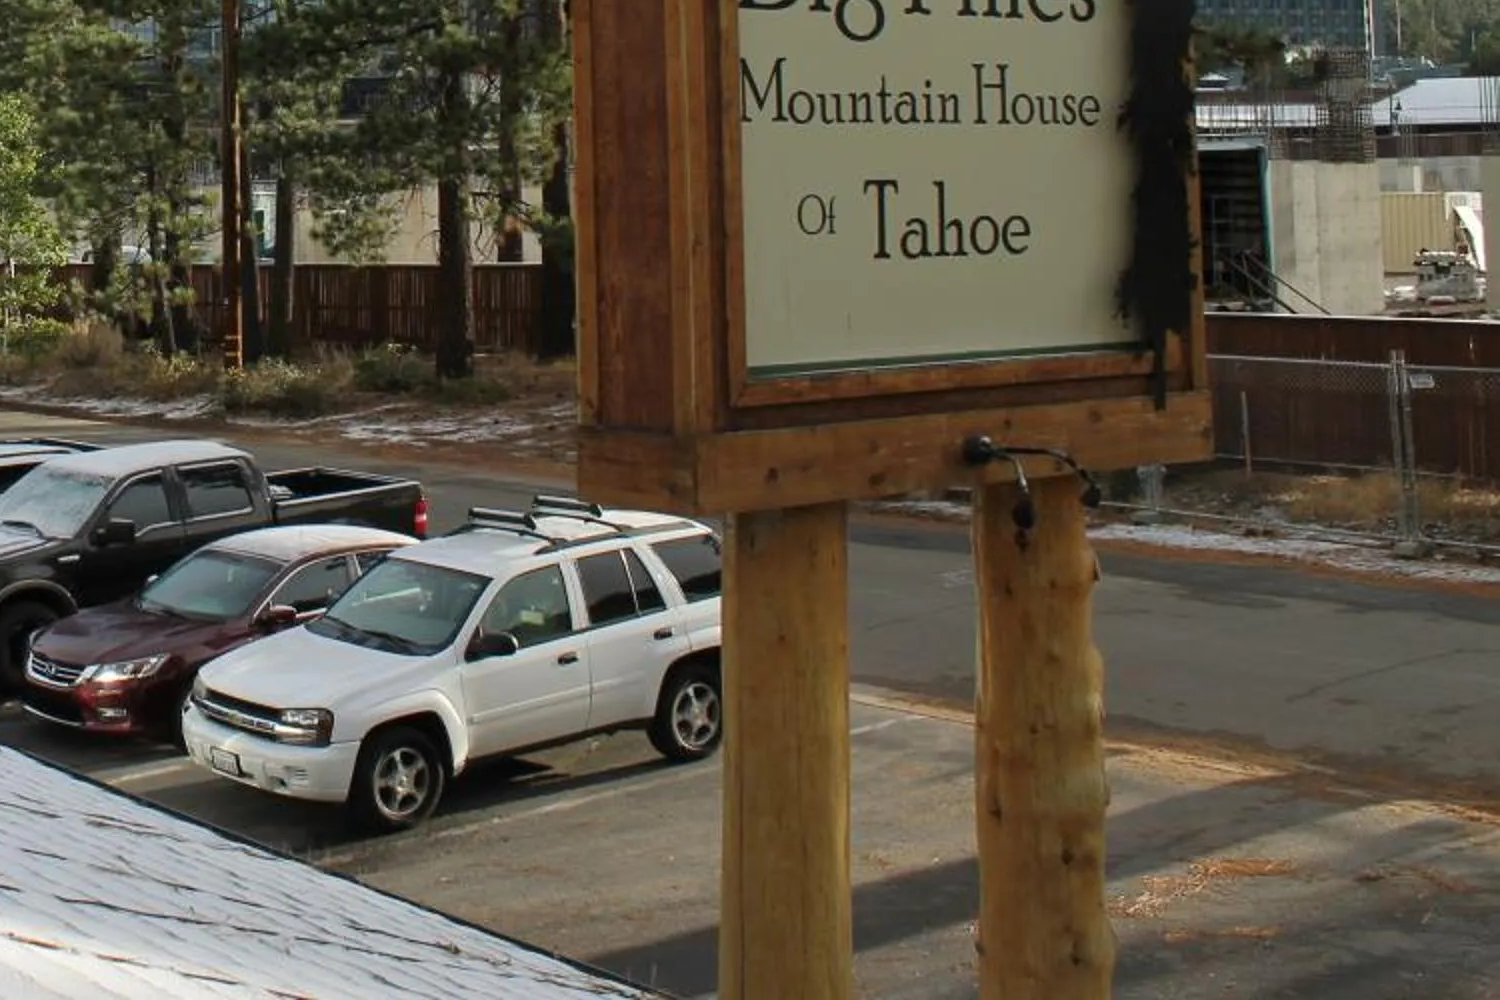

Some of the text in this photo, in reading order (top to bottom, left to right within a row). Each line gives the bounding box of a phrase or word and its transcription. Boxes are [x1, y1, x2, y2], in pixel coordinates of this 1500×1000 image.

[740, 57, 1101, 127] Mountain House
[797, 179, 1031, 260] Of Tahoe
